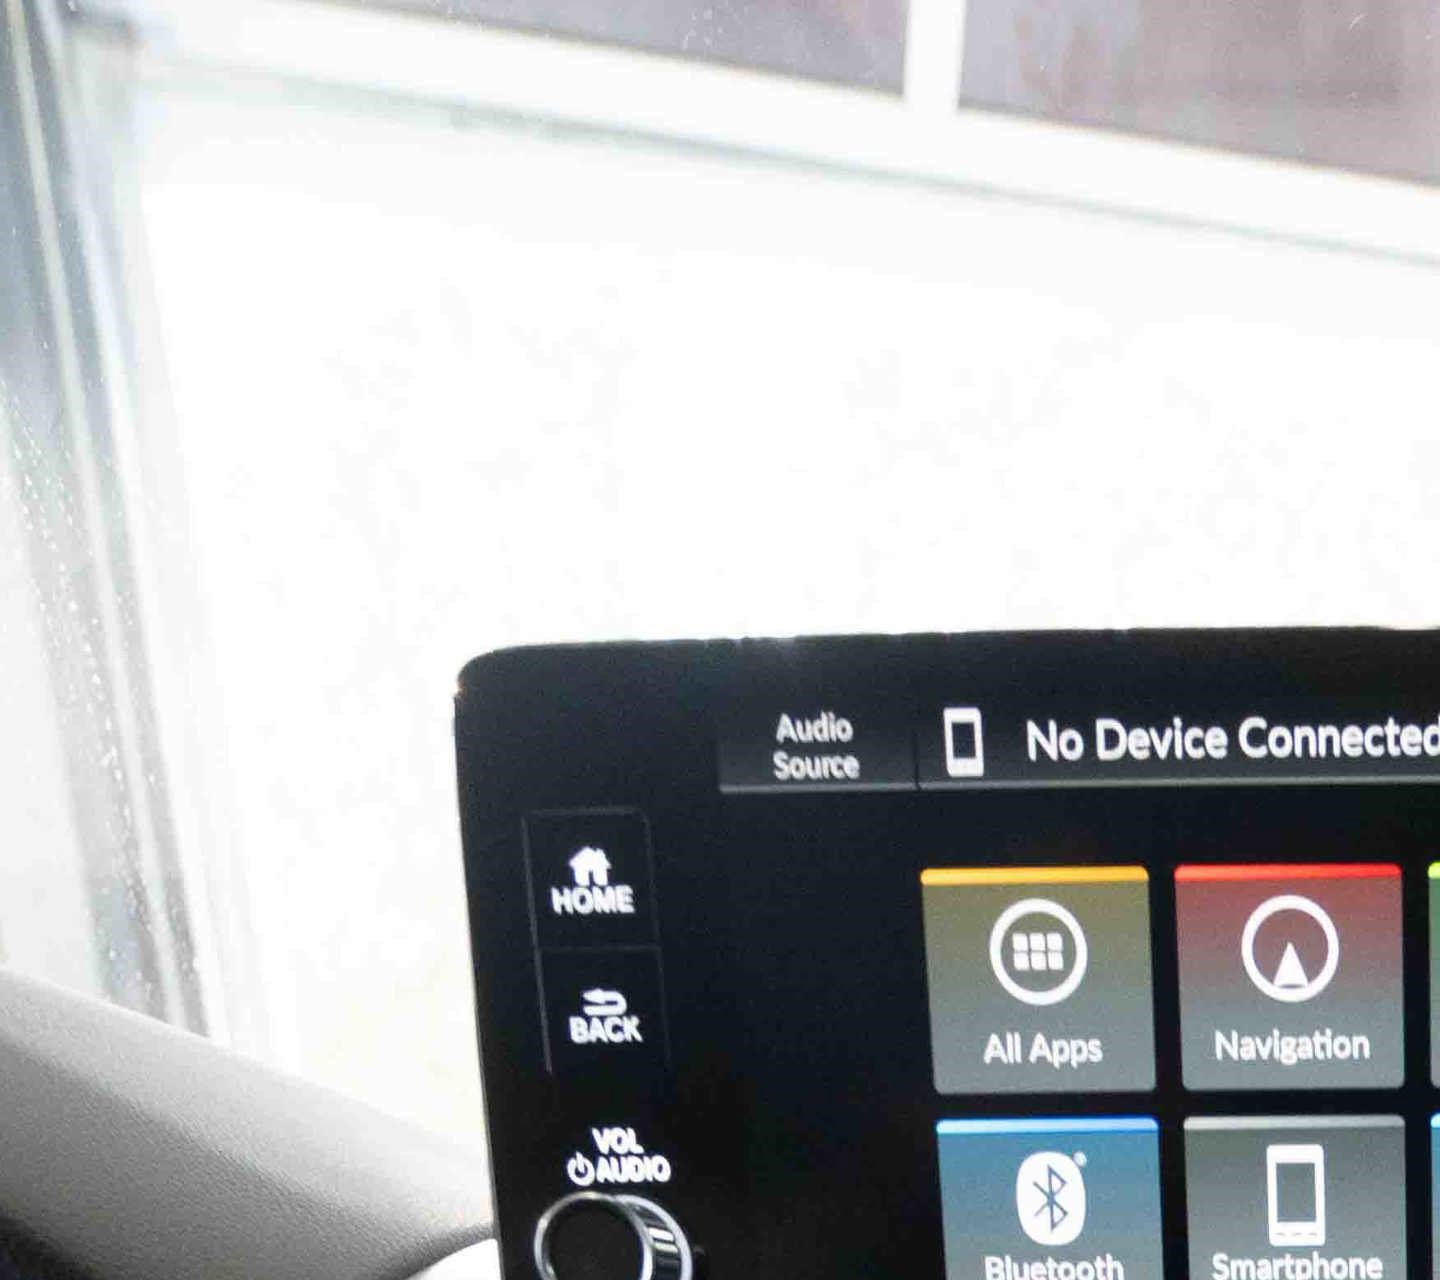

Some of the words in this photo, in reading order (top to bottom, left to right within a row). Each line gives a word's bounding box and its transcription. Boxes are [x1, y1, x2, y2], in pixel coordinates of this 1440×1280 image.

[776, 712, 852, 744] Audio
[1027, 719, 1084, 761] No
[1096, 719, 1227, 760] Device
[774, 752, 859, 779] Source
[552, 886, 634, 914] HOME
[570, 1017, 642, 1043] BACK
[984, 1032, 1023, 1063] All
[1031, 1032, 1103, 1068] Apps
[1215, 1029, 1370, 1066] Navigation
[593, 1127, 643, 1154] VOL
[596, 1156, 671, 1183] AUDIO
